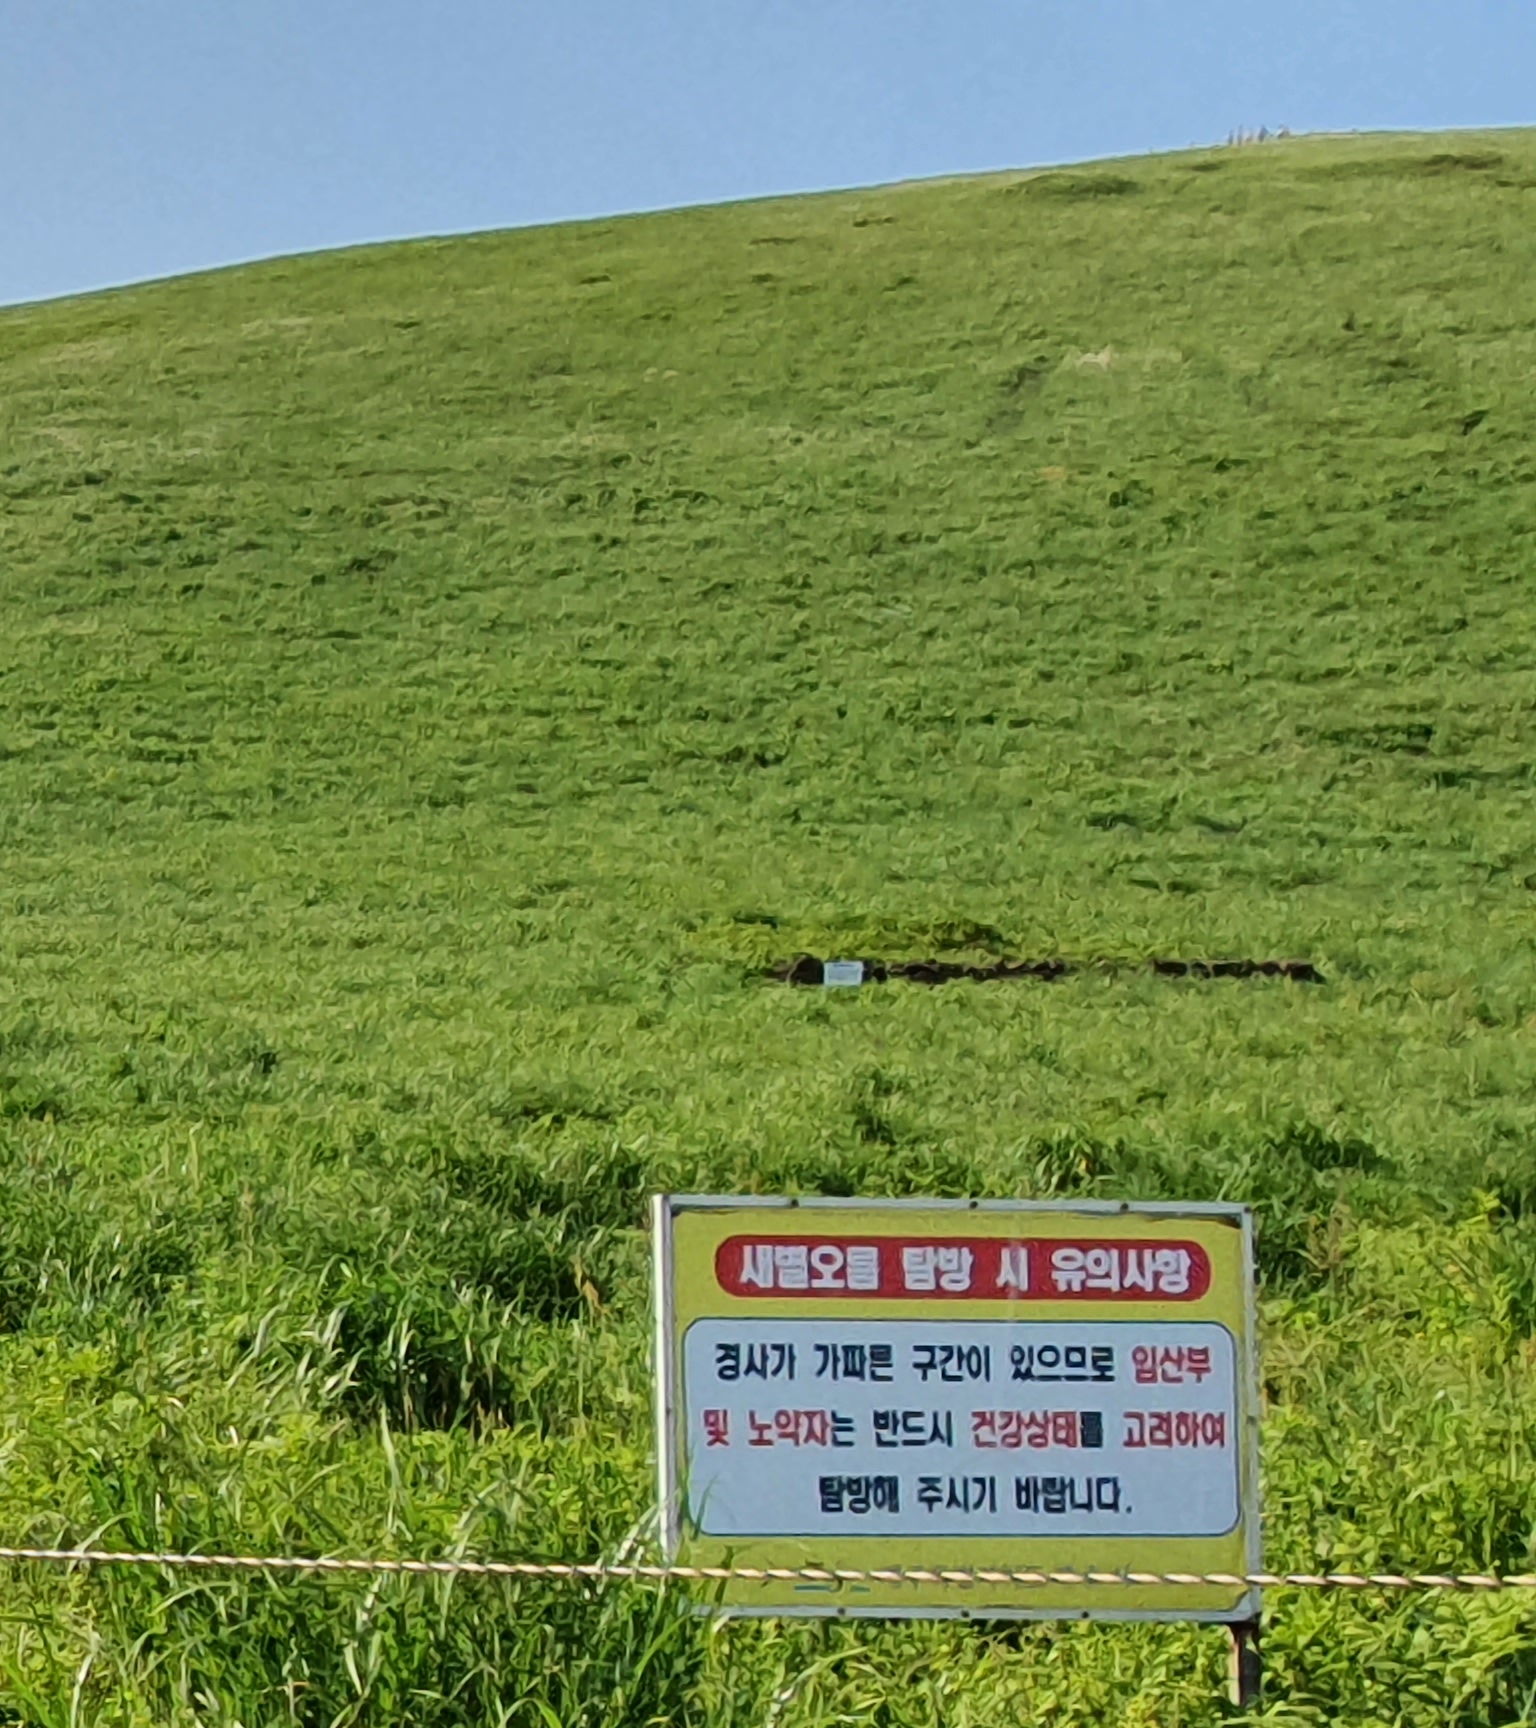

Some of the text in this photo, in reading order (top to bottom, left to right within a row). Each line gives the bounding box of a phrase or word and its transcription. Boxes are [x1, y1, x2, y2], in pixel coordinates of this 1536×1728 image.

[739, 1244, 1191, 1294] 새별오름 탐방 시 유의사항
[715, 1343, 1212, 1384] 경사가 가파른 구간이 있으므로 임산부
[703, 1409, 1226, 1449] 및 노약자는 반드시 건강상태를 고려하여
[819, 1475, 1133, 1514] 탐방해 주시기 바랍니다.
